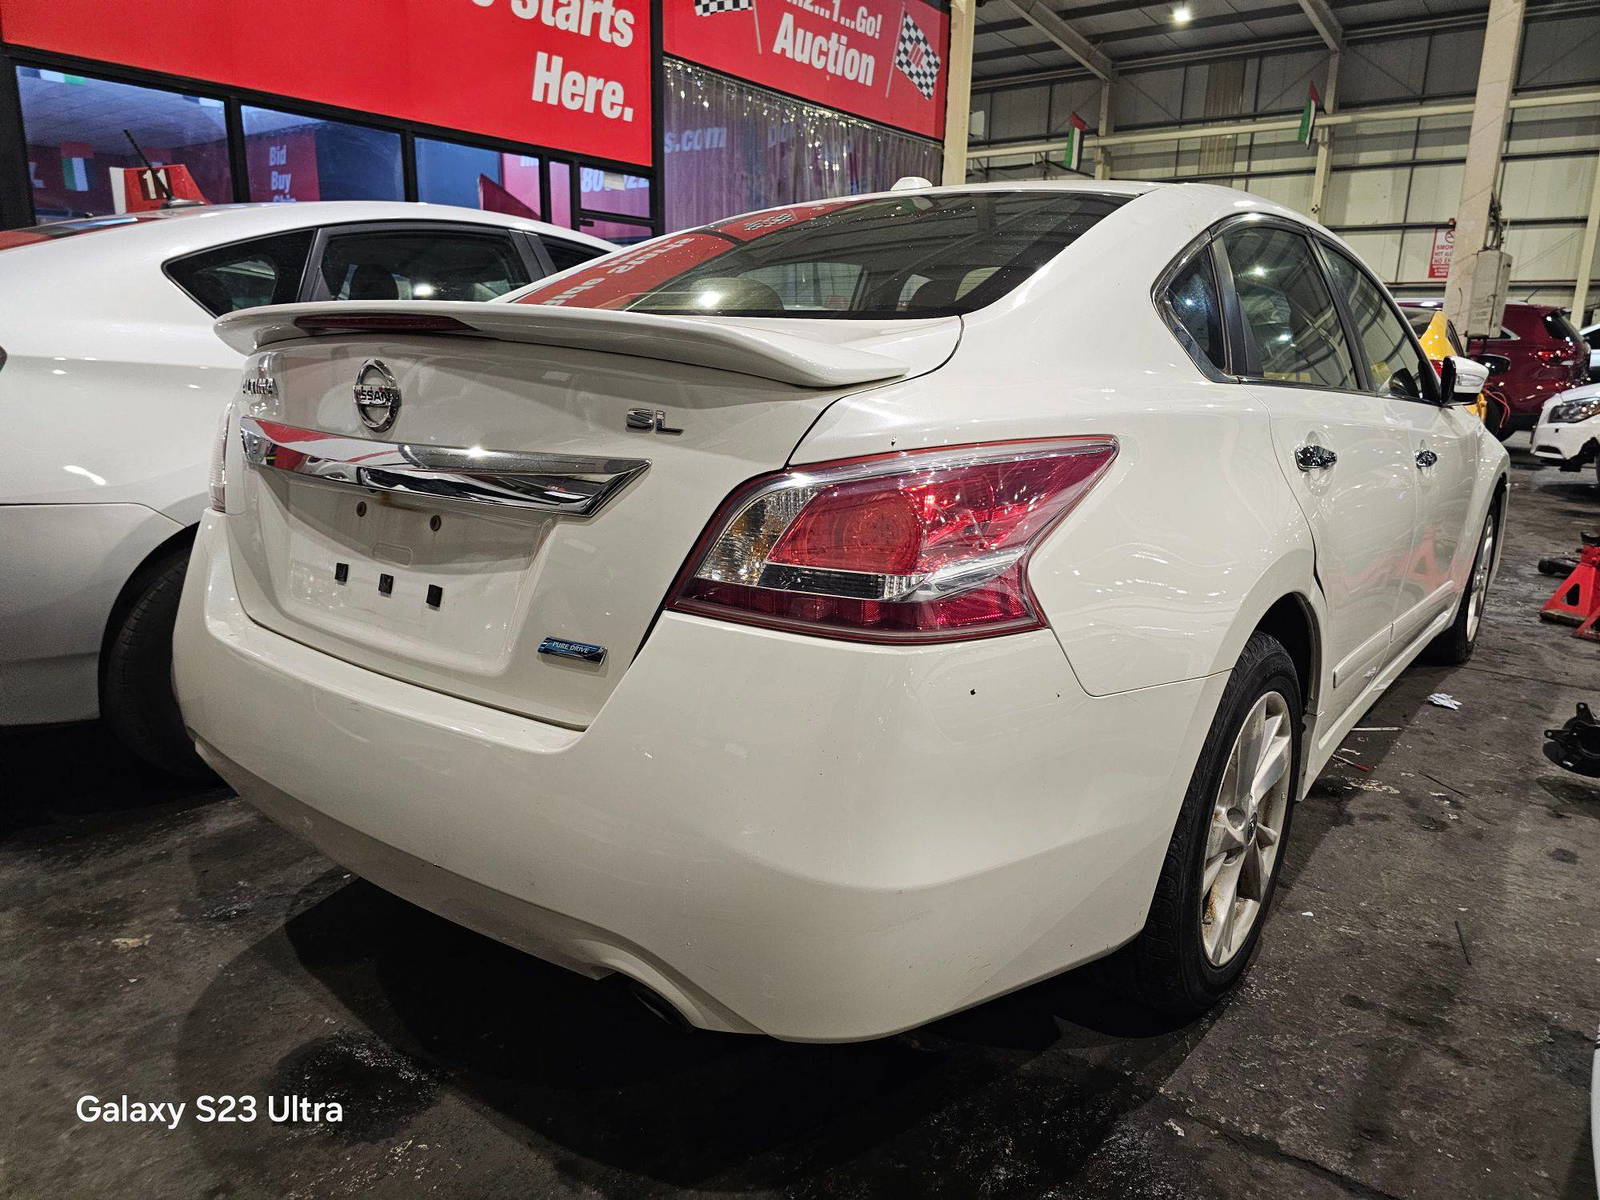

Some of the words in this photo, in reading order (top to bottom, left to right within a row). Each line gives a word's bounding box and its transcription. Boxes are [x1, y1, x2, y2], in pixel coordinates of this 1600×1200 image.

[772, 12, 876, 86] Auction
[532, 51, 634, 122] Here.
[269, 144, 287, 166] Bid
[271, 171, 292, 193] Buy
[626, 408, 684, 435] SL
[552, 641, 569, 650] PURE
[569, 643, 589, 654] DRIVE
